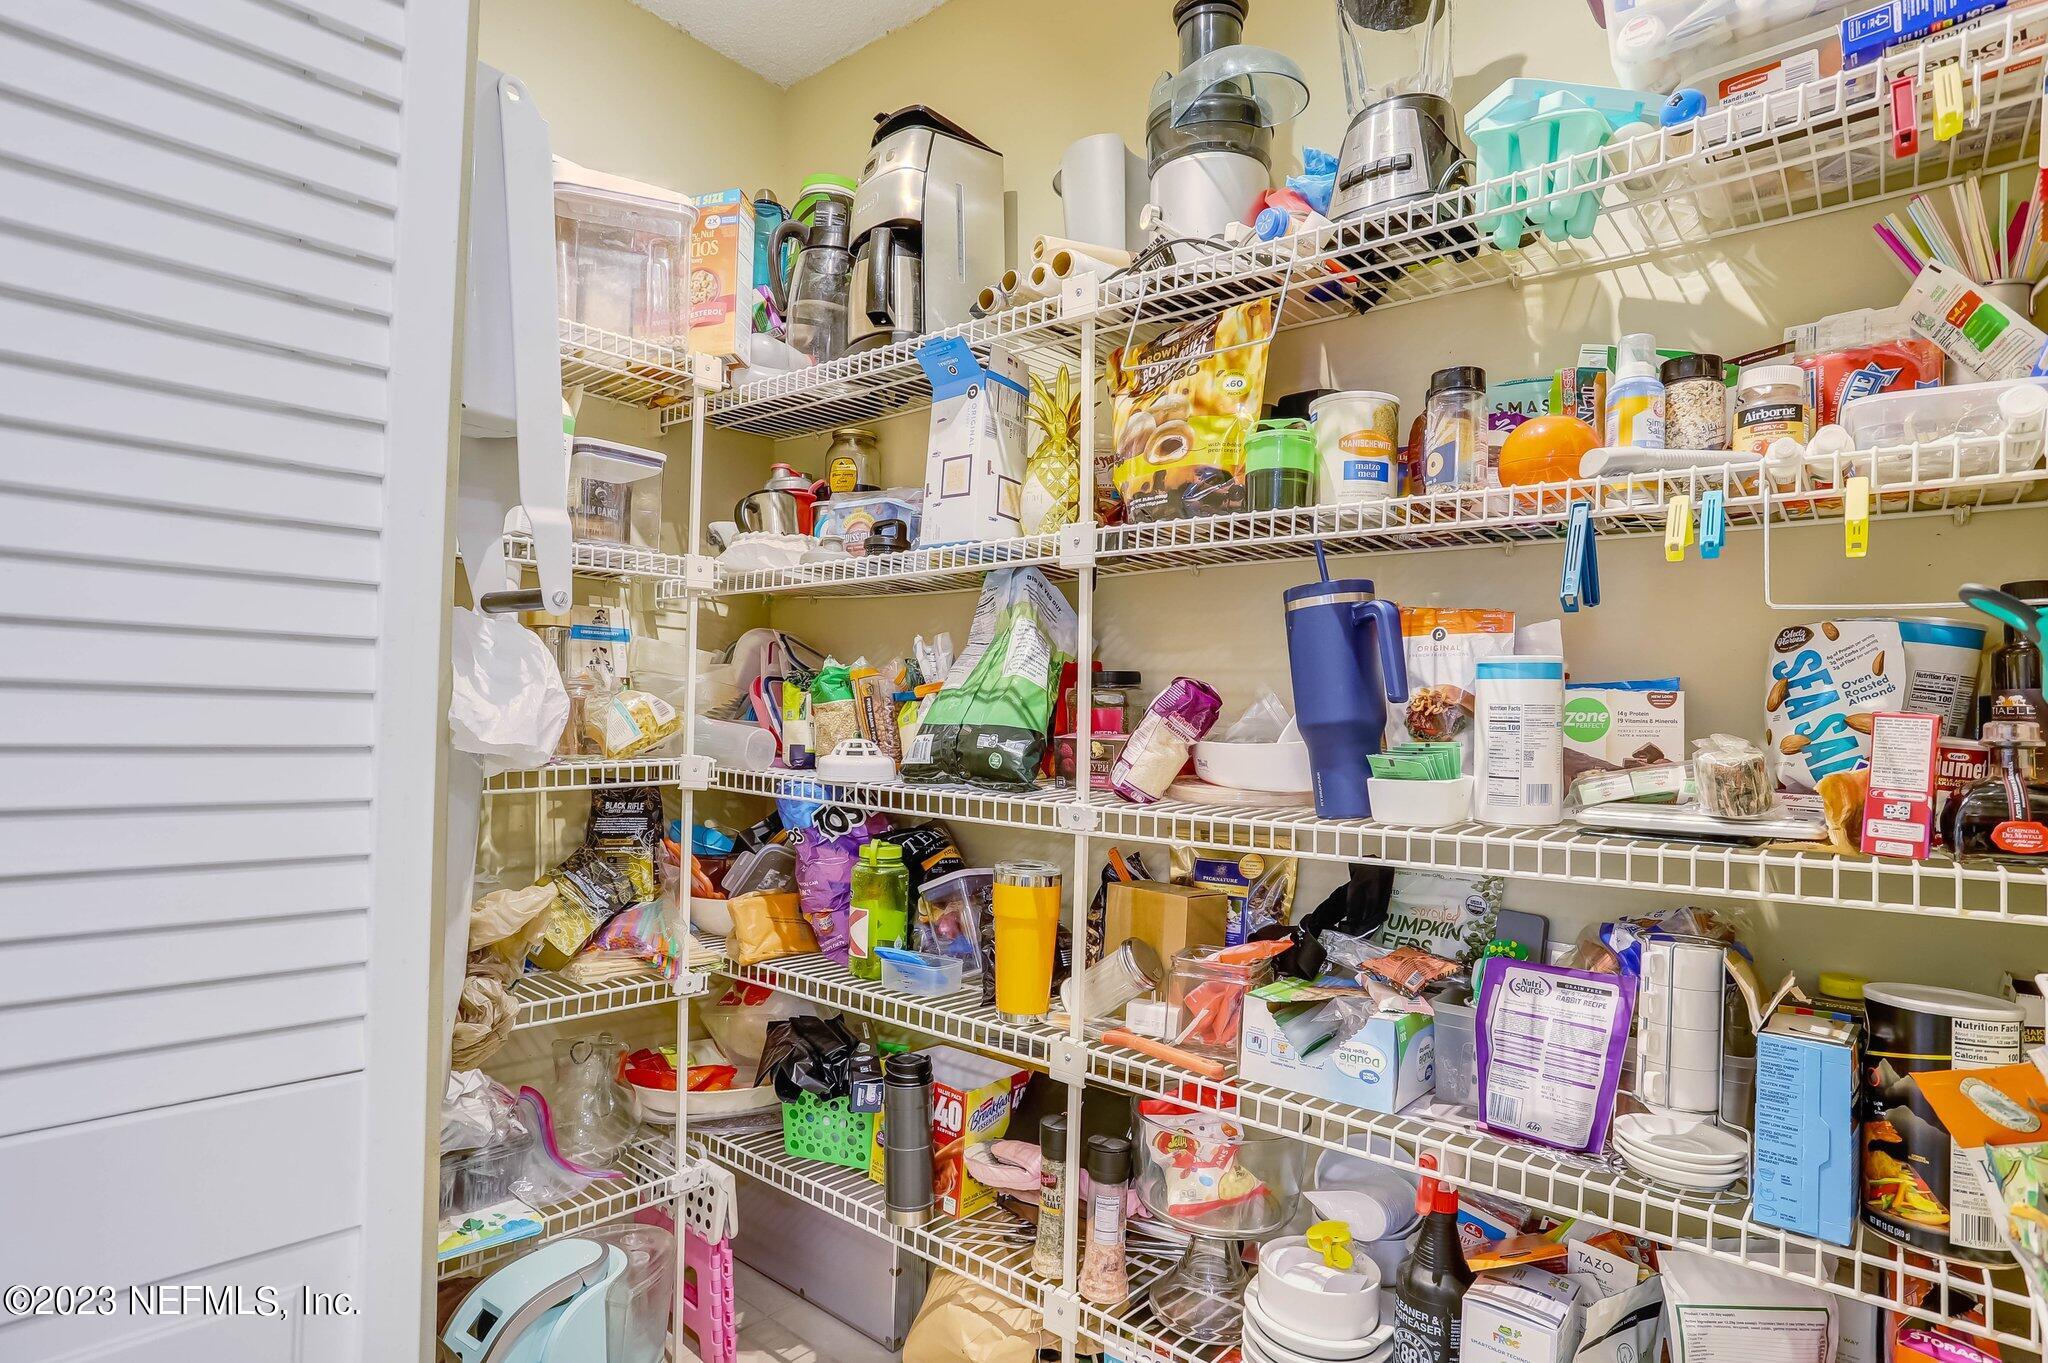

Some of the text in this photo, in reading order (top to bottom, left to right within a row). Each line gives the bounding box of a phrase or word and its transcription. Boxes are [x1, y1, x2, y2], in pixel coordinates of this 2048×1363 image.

[1730, 75, 1767, 92] Rubbermaid
[1723, 90, 1757, 105] Handi-Box
[700, 230, 714, 239] Nut
[1142, 343, 1180, 366] BROWN
[1833, 371, 1851, 405] POPCORN
[1744, 406, 1796, 424] Airborne
[968, 402, 978, 448] ORIGINAL
[1753, 424, 1785, 432] SIMPLY-C
[1341, 439, 1392, 451] MANISCHEWITZ
[1355, 463, 1381, 471] matzo
[1357, 470, 1378, 478] meal
[1027, 574, 1038, 583] DIG
[1417, 645, 1461, 653] ORIGINAL
[1838, 643, 1855, 655] Protein
[1845, 649, 1859, 658] Carbs
[1844, 656, 1856, 665] Fiber
[1841, 674, 1872, 690] Oven
[1915, 671, 1957, 683] Nutrition Facts
[1772, 649, 1841, 721] SEA
[1844, 674, 1890, 699] Roasted
[1849, 683, 1896, 707] Almonds
[1911, 693, 1952, 703] Calories 100
[1564, 711, 1609, 727] zone
[1164, 721, 1190, 744] Jasmine
[1795, 712, 1865, 783] SAL
[605, 801, 645, 811] BLACK RIFLE
[1411, 905, 1461, 925] sprouted
[1386, 913, 1464, 941] UMPKIN
[1514, 982, 1545, 996] Source
[1520, 977, 1542, 987] Nutri
[1555, 994, 1582, 1005] RABBIT
[1583, 1000, 1608, 1010] RECIPE
[1954, 1020, 2019, 1033] Nutrition Facts
[1954, 1036, 1975, 1044] Serving
[1339, 1052, 1380, 1068] Double
[1954, 1051, 2018, 1062] Calories 100
[1760, 1079, 1778, 1087] GLUTEN
[937, 1087, 963, 1100] VALUE PACK
[934, 1095, 962, 1132] 40
[970, 1094, 1011, 1132] Breakfast
[977, 1109, 1006, 1132] ESSENTIALS
[937, 1126, 957, 1138] SERVINGS
[1168, 1136, 1187, 1149] Jelly
[1882, 1221, 1887, 1230] 13
[1887, 1224, 1894, 1234] OZ
[1577, 1250, 1614, 1274] TAZO
[1432, 1315, 1440, 1327] &
[1470, 1338, 1507, 1357] SMARTCHLOR
[1491, 1331, 1521, 1350] FROG
[1401, 1342, 1418, 1363] 88
